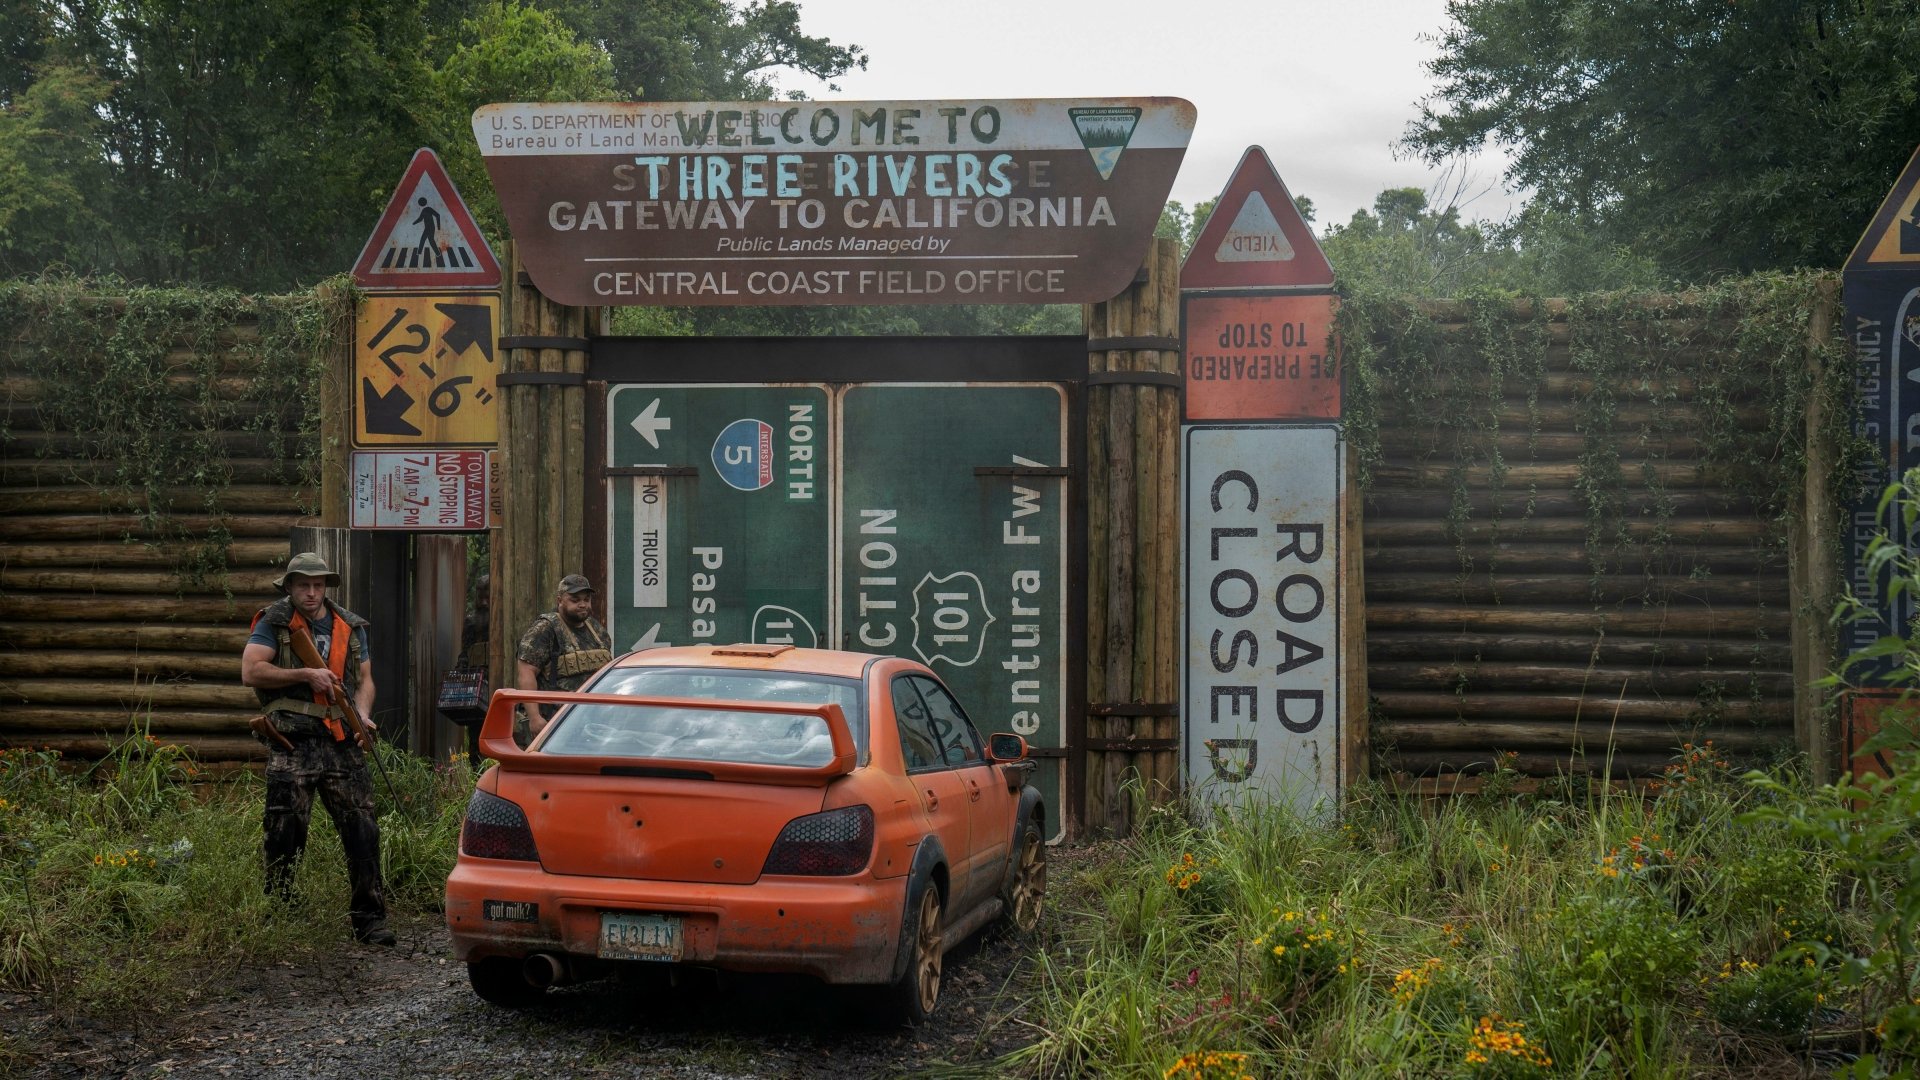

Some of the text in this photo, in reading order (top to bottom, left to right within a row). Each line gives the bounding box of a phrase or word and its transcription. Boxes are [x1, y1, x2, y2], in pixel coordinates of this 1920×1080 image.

[491, 116, 508, 130] U.
[512, 115, 527, 130] S.
[532, 113, 647, 130] DEPARTMENT
[651, 113, 673, 128] OF
[492, 134, 557, 149] Bureau
[565, 132, 583, 148] of
[590, 132, 634, 148] Land
[674, 105, 1001, 147] WELCOME TO
[635, 155, 804, 200] THREE
[833, 153, 1013, 198] RIVERS
[548, 196, 1117, 232] GATEWAY TO CALIFORNIA
[717, 236, 950, 254] Public Lands Managed by
[1232, 235, 1279, 252] YIELD
[593, 269, 1065, 296] CENTRAL COAST FIELD OFFICE
[1218, 322, 1308, 348] TO STOP
[1191, 355, 1300, 380] PREPARED
[1852, 316, 1882, 411] AGENCY
[724, 444, 752, 465] 5
[759, 430, 769, 479] INTERSTATE
[789, 404, 813, 499] NORTH
[403, 456, 430, 525] 7 AM TO 7 PM
[438, 453, 462, 524] NO STOPPING
[467, 454, 482, 525] TOW-AWAY
[642, 484, 659, 587] NO TRUCKS
[692, 546, 723, 647] Pasa
[858, 509, 898, 653] CTION
[932, 592, 970, 647] 101
[1209, 469, 1260, 784] CLOSED
[1275, 523, 1325, 734] ROAD
[1001, 570, 1042, 742] entura
[490, 903, 531, 920] got milk?
